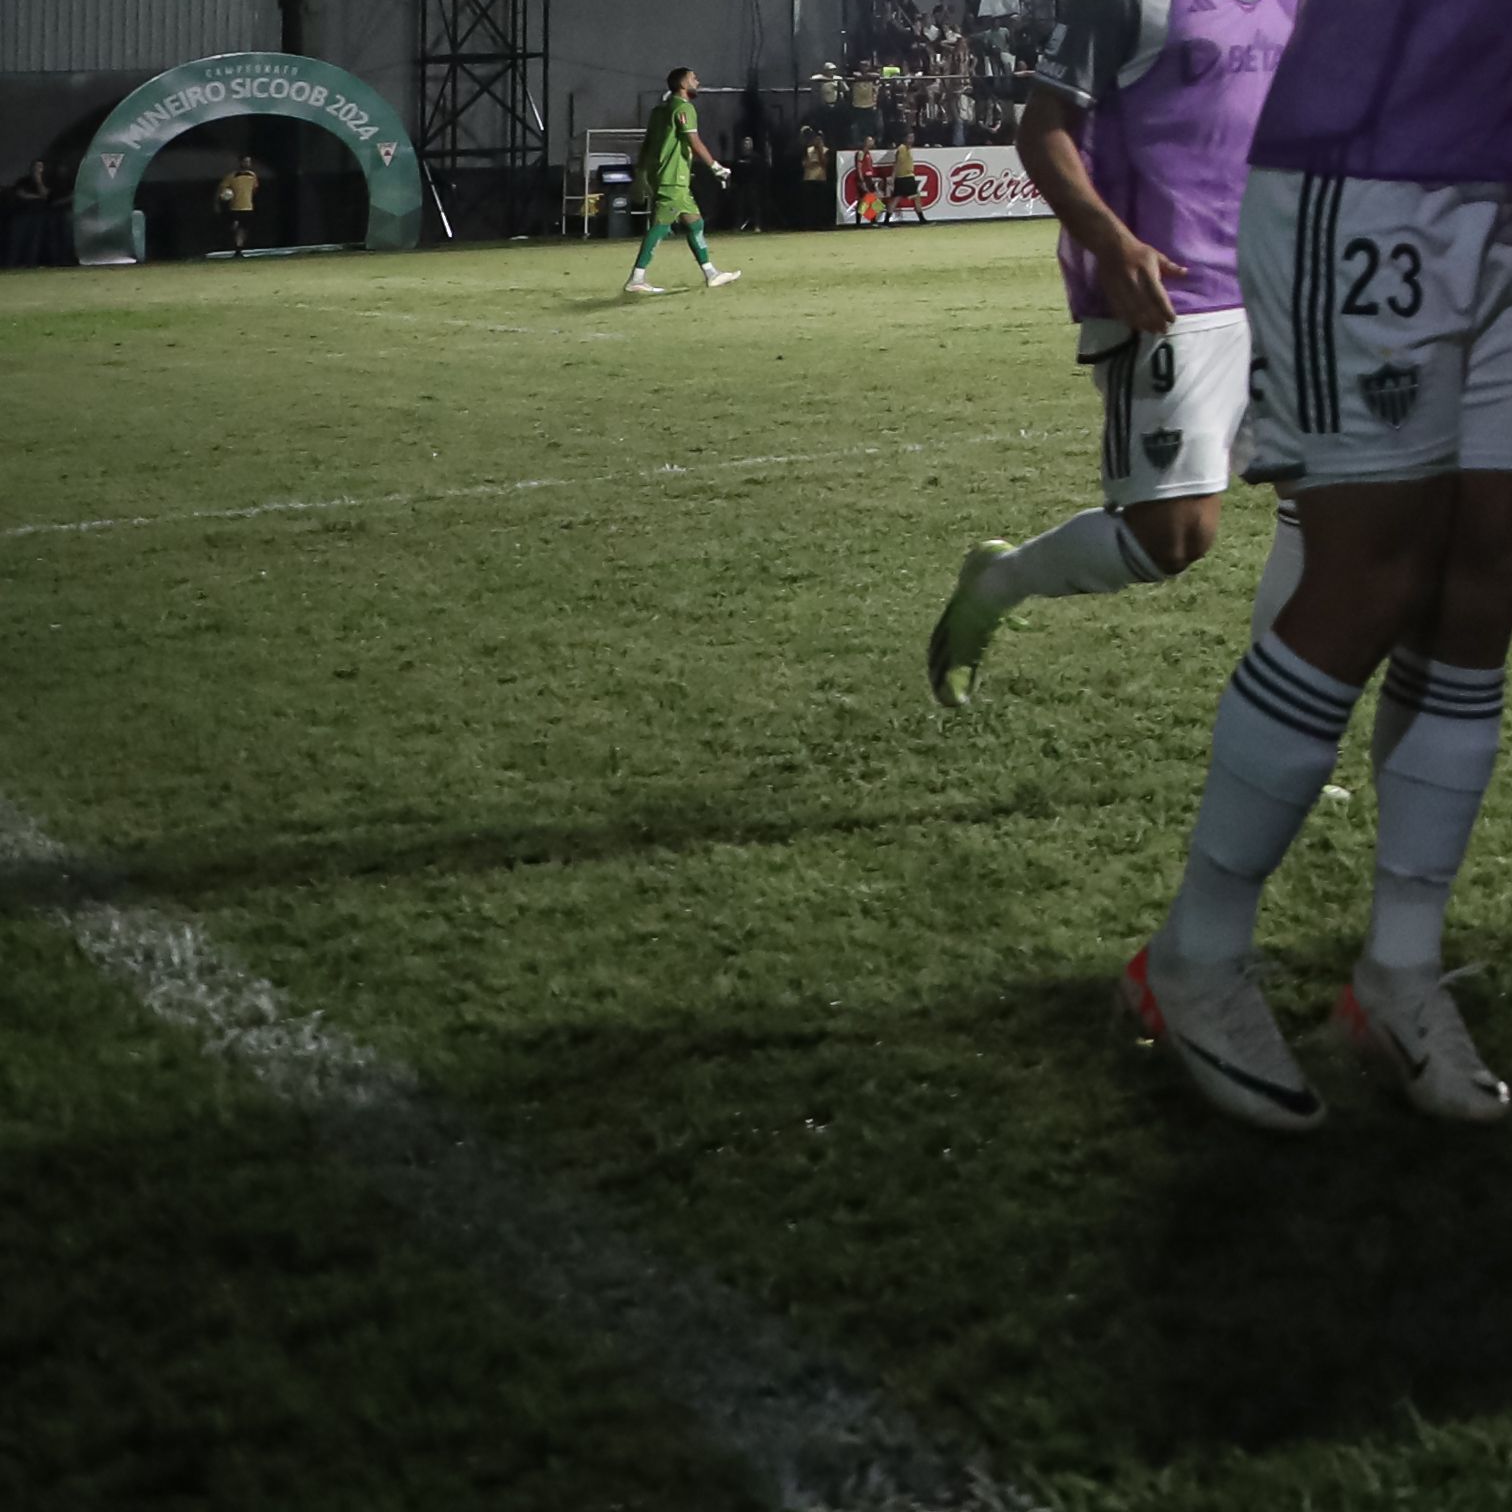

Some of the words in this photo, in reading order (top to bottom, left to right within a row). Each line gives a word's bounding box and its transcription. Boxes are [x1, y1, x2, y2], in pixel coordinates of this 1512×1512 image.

[120, 80, 226, 150] MINEIRO
[230, 77, 329, 107] SICOOB
[325, 93, 380, 140] 2024
[1342, 237, 1422, 318] 23
[1151, 342, 1175, 392] 9
